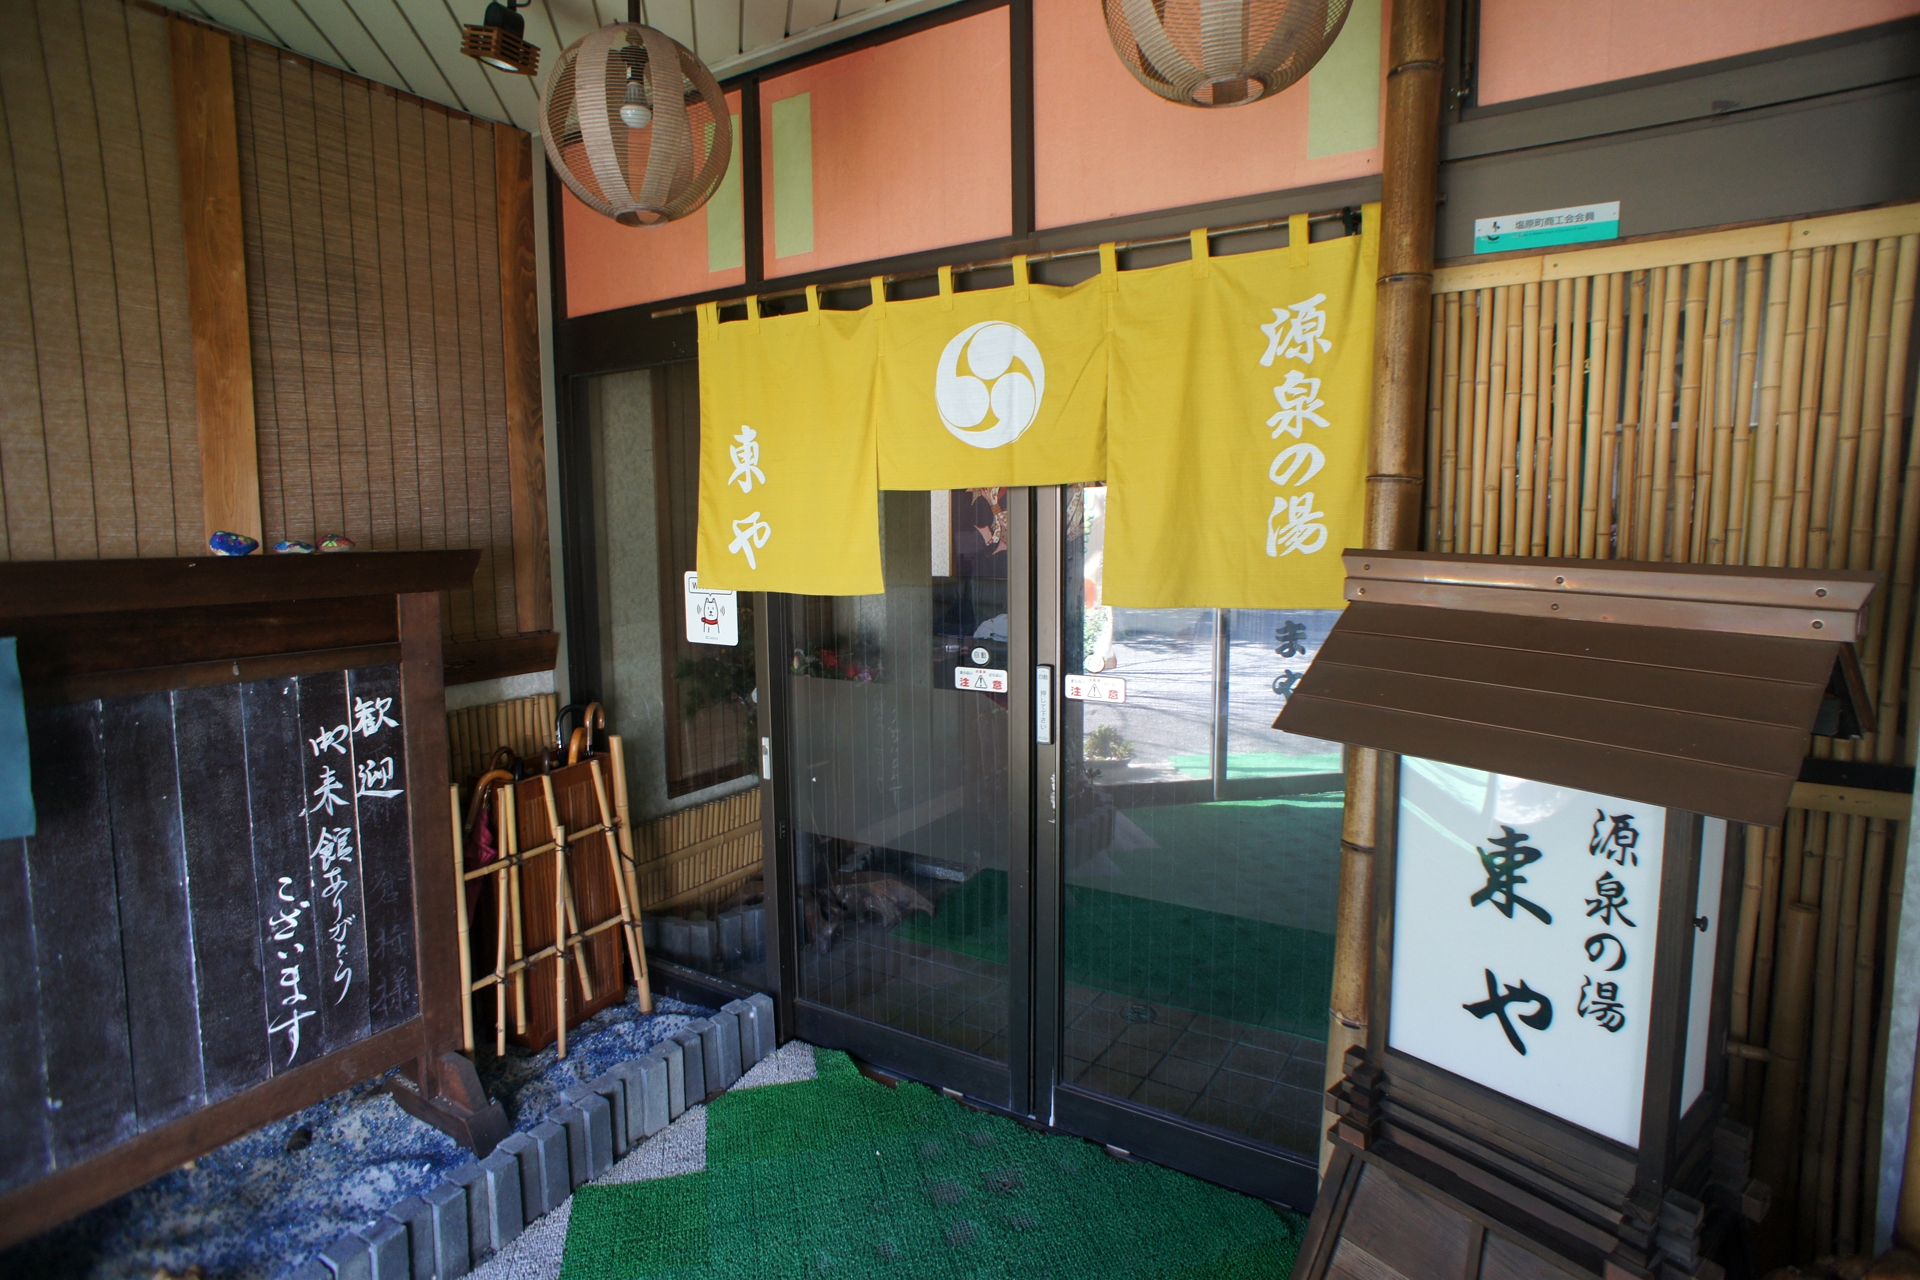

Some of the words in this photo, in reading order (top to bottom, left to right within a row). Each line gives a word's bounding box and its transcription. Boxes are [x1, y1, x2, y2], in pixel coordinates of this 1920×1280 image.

[1514, 211, 1596, 230] 塩原町商工会会員
[1258, 293, 1333, 558] 源泉の湯
[727, 424, 772, 571] 東や
[973, 651, 987, 659] 自動
[1037, 673, 1049, 681] 自動
[352, 695, 405, 800] 歓迎
[1039, 689, 1048, 730] 押して下さい
[1462, 825, 1553, 1056] 東や
[1577, 808, 1640, 1034] 源泉の湯
